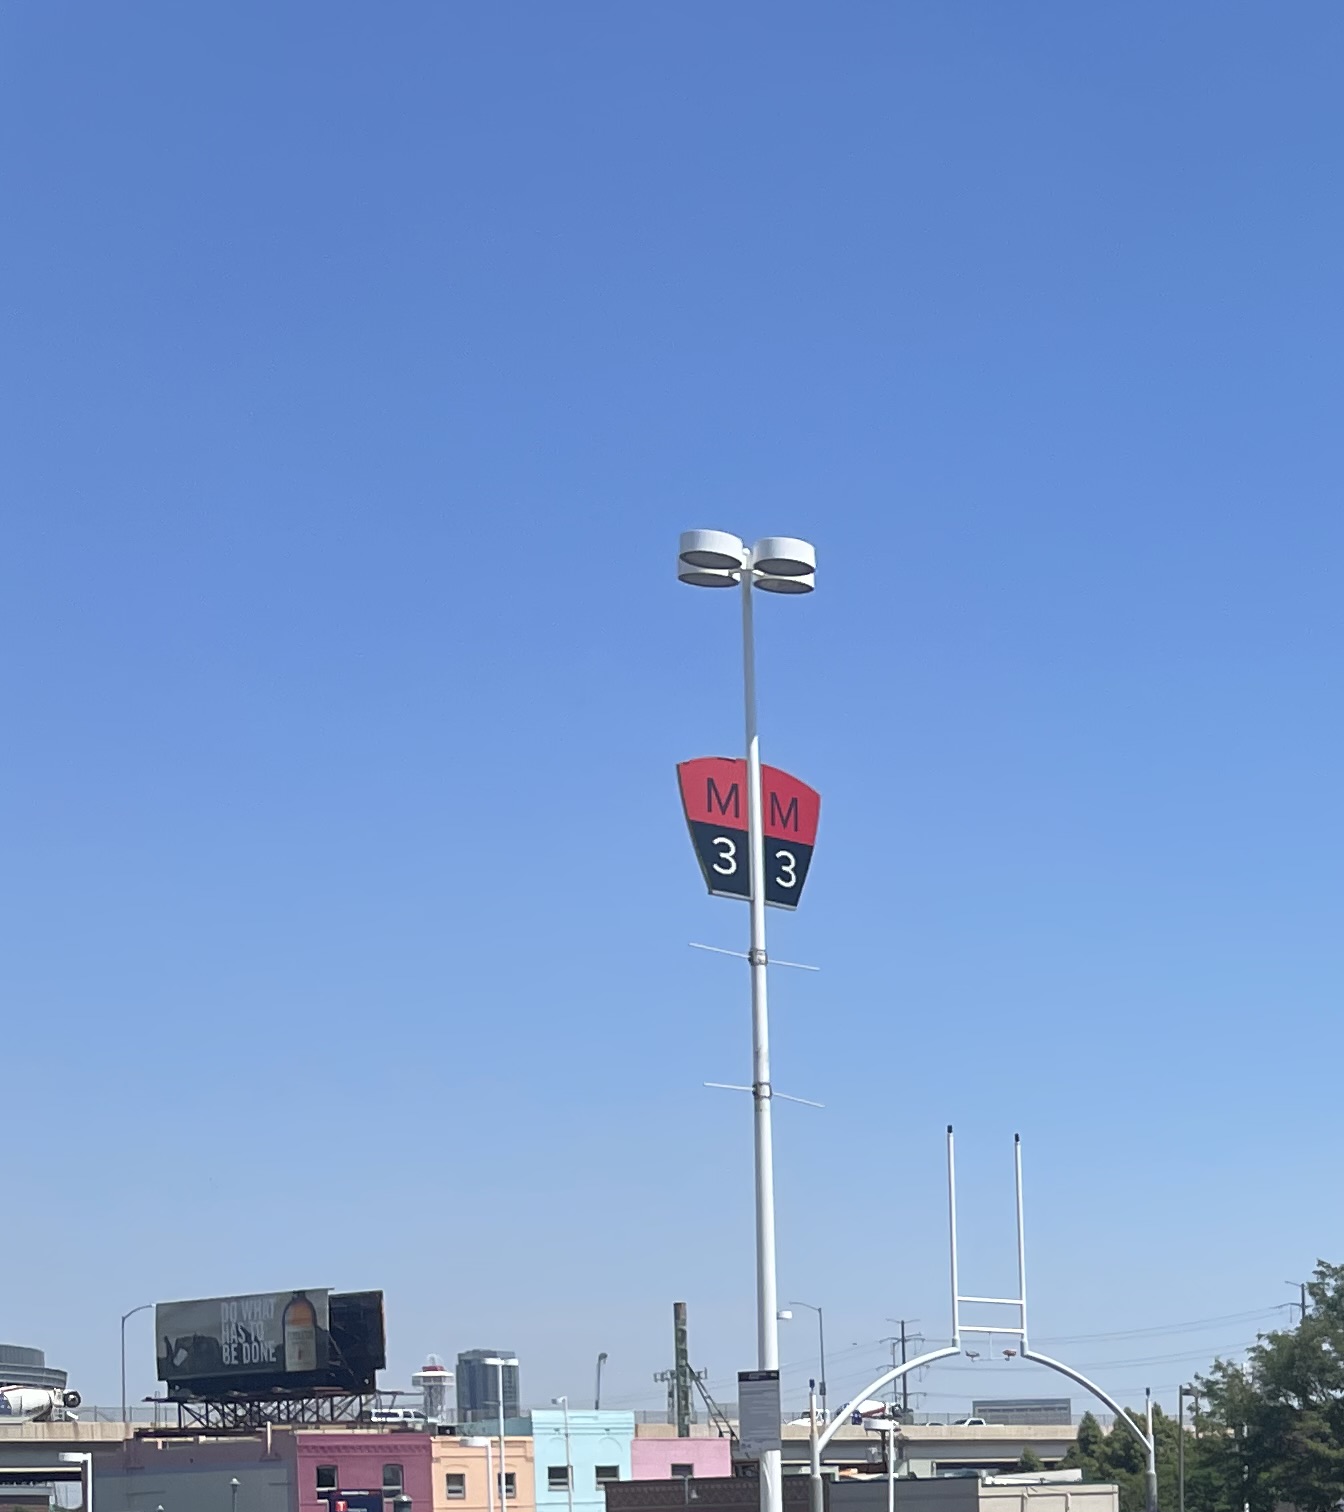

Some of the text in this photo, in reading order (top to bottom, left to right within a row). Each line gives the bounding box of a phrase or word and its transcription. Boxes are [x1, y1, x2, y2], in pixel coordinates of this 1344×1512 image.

[706, 777, 740, 819] M
[769, 791, 799, 832] M
[712, 836, 737, 875] 3
[775, 850, 797, 888] 3
[221, 1299, 275, 1323] DO WHAT
[221, 1321, 246, 1344] HAS
[250, 1320, 265, 1342] TO
[222, 1340, 277, 1365] BE DONE
